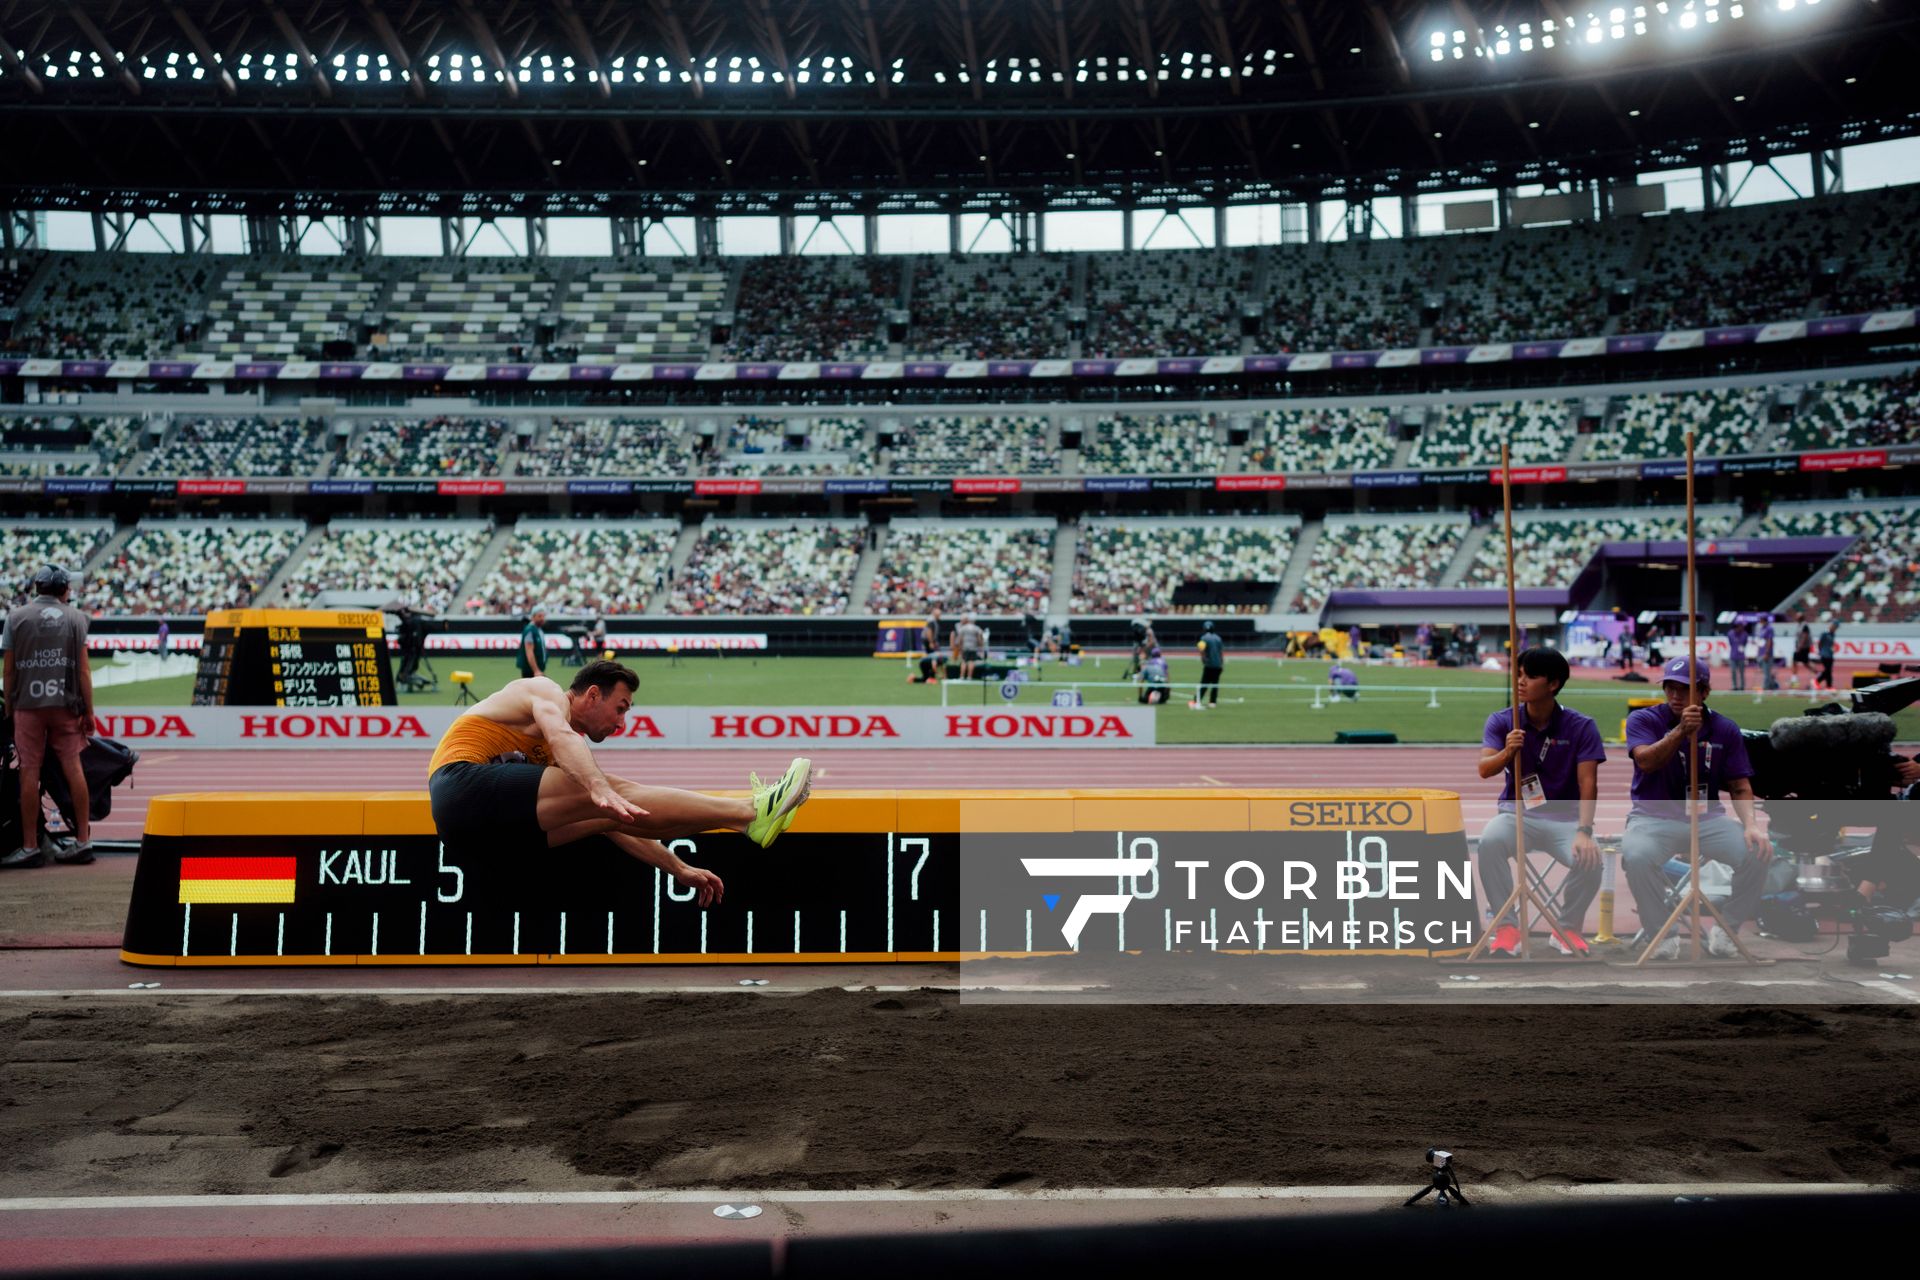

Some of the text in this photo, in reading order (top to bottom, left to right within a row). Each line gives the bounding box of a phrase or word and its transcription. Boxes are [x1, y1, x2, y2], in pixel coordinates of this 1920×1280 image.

[34, 648, 62, 658] HOST
[240, 715, 429, 738] HONDA
[711, 715, 899, 738] HONDA
[945, 715, 1131, 738] HONDA
[1289, 801, 1413, 826] SEIKO
[319, 849, 411, 885] KAUL
[437, 840, 464, 903] 5
[900, 838, 930, 900] 7
[1129, 837, 1159, 900] 8
[1359, 836, 1388, 899] 9
